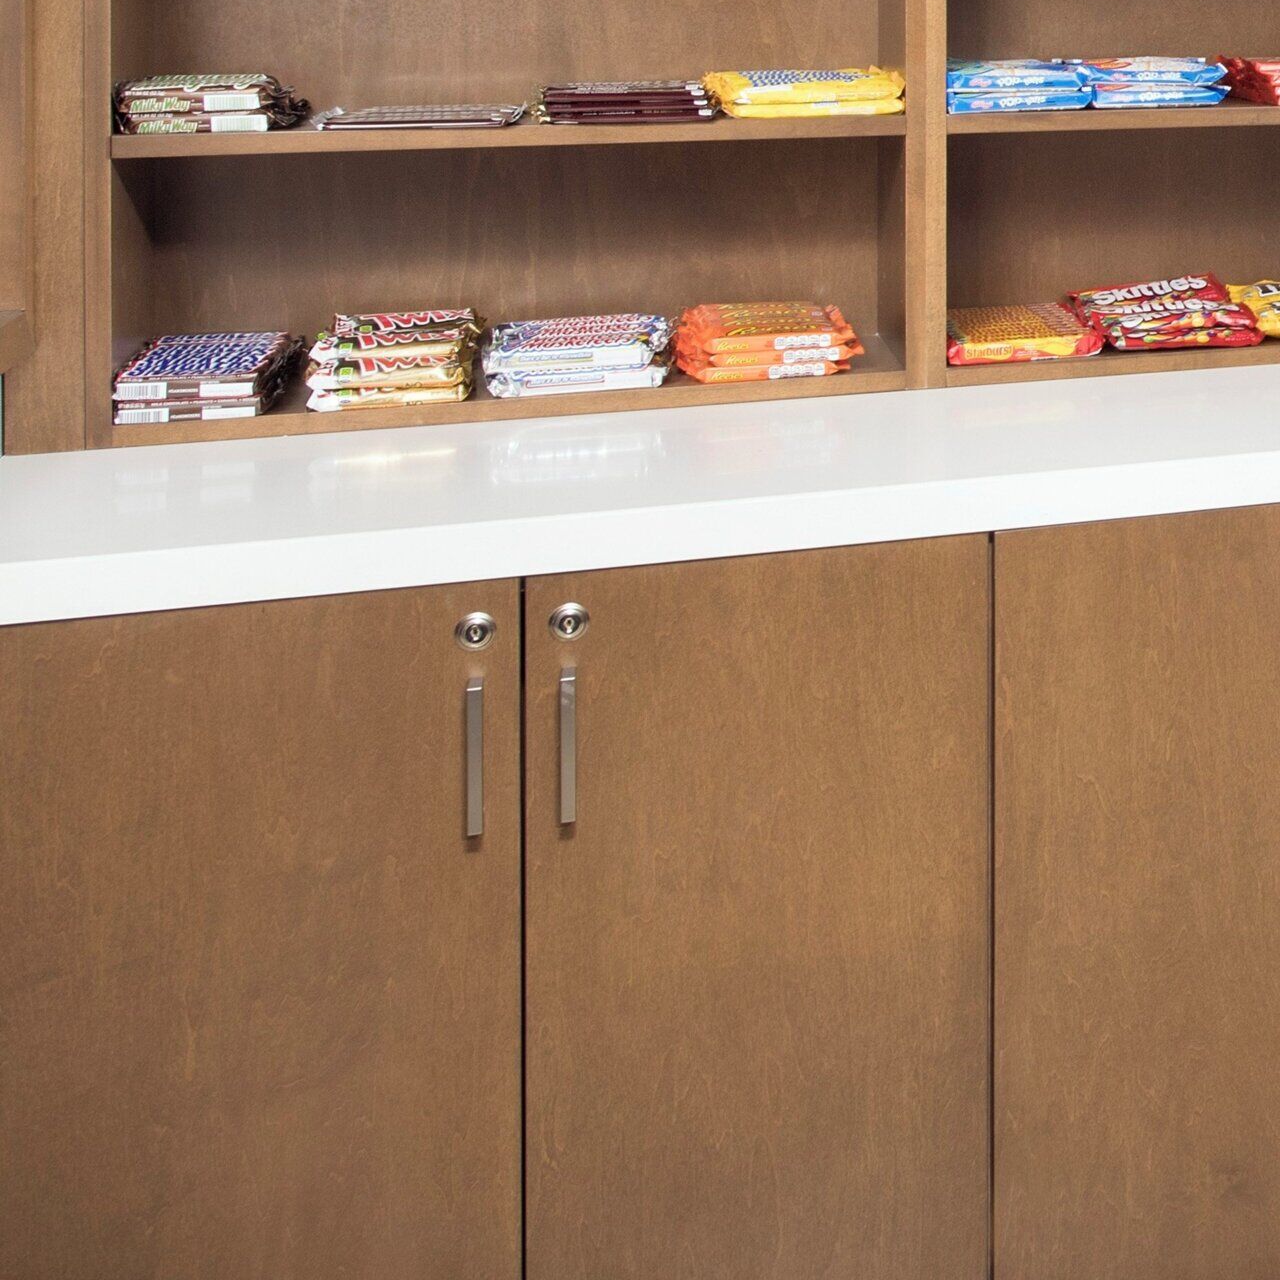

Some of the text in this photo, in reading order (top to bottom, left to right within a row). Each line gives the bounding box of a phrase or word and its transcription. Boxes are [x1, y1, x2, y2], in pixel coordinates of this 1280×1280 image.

[130, 96, 192, 113] Milky Way
[138, 118, 198, 134] Milky Way
[1091, 275, 1208, 305] Skittles
[964, 345, 1014, 359] Starburst
